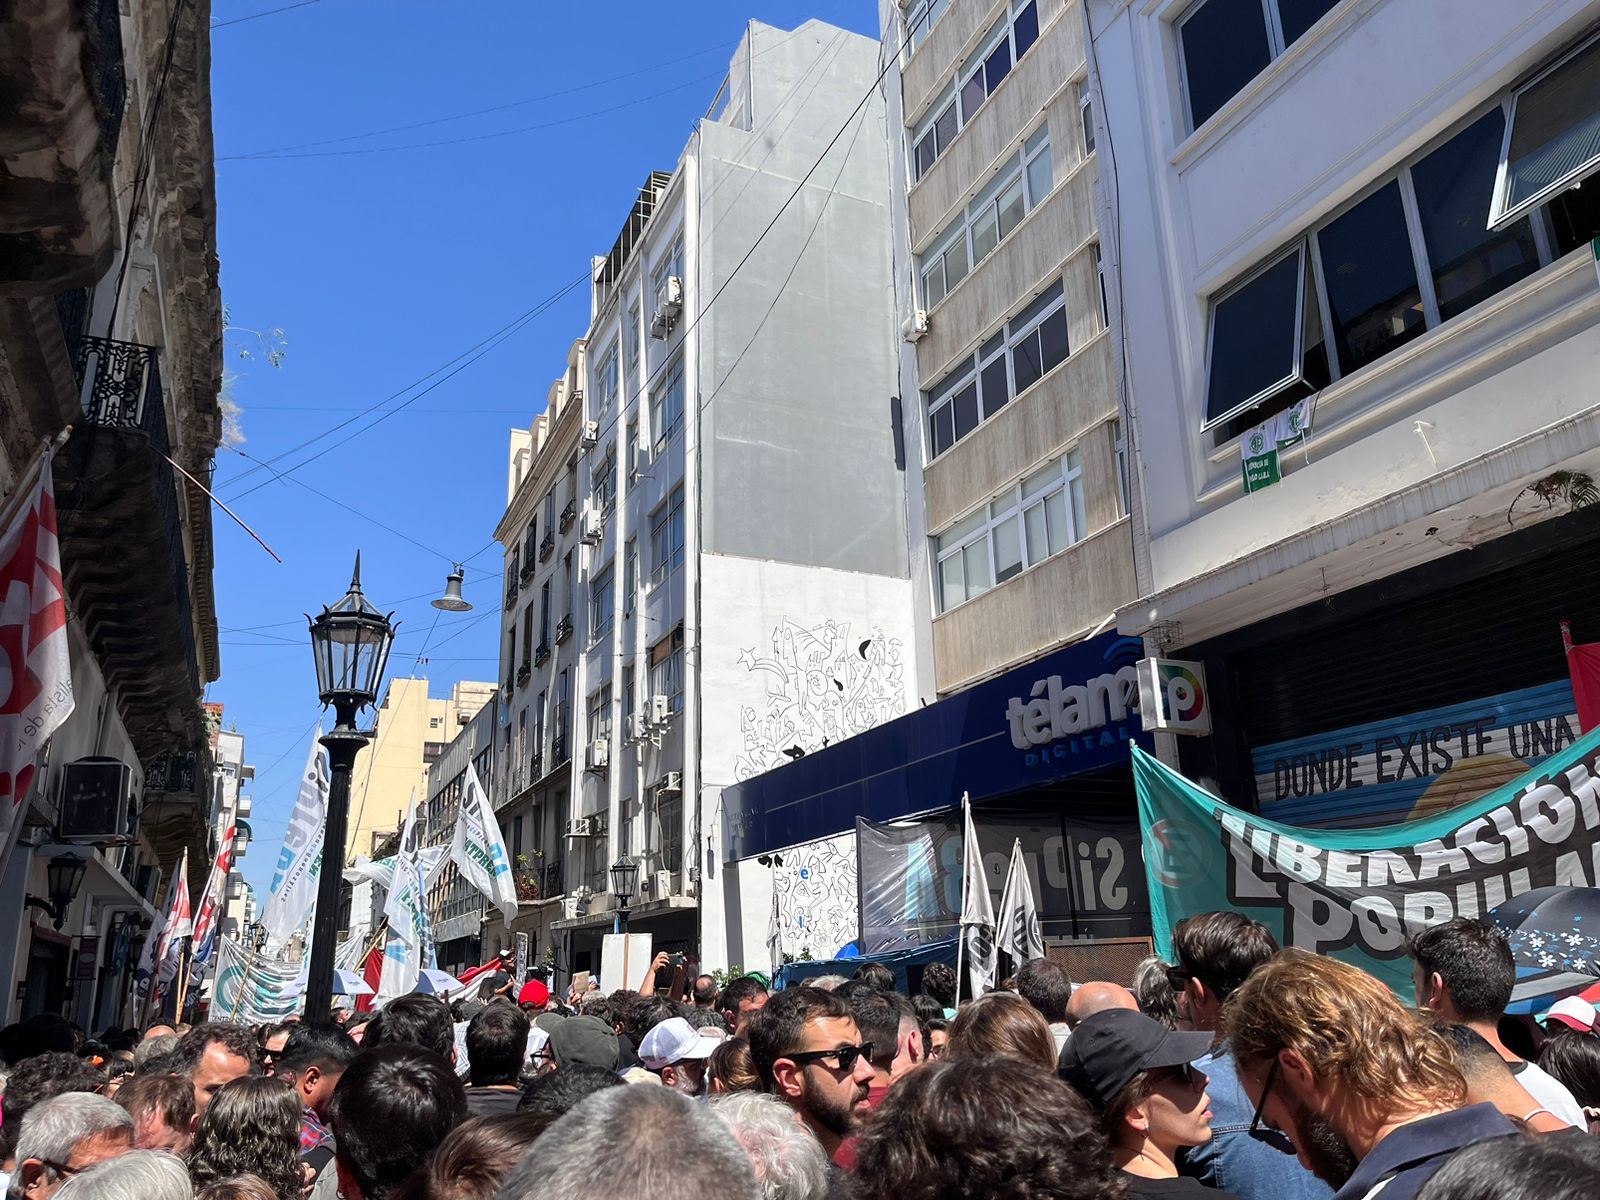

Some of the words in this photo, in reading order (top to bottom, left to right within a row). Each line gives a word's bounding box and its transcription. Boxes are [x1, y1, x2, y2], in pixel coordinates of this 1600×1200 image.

[1006, 665, 1141, 750] télam
[1025, 725, 1131, 768] DIGITAL
[1274, 742, 1365, 802] DONDE
[1375, 716, 1496, 785] EXISTE
[1507, 714, 1578, 759] UNA
